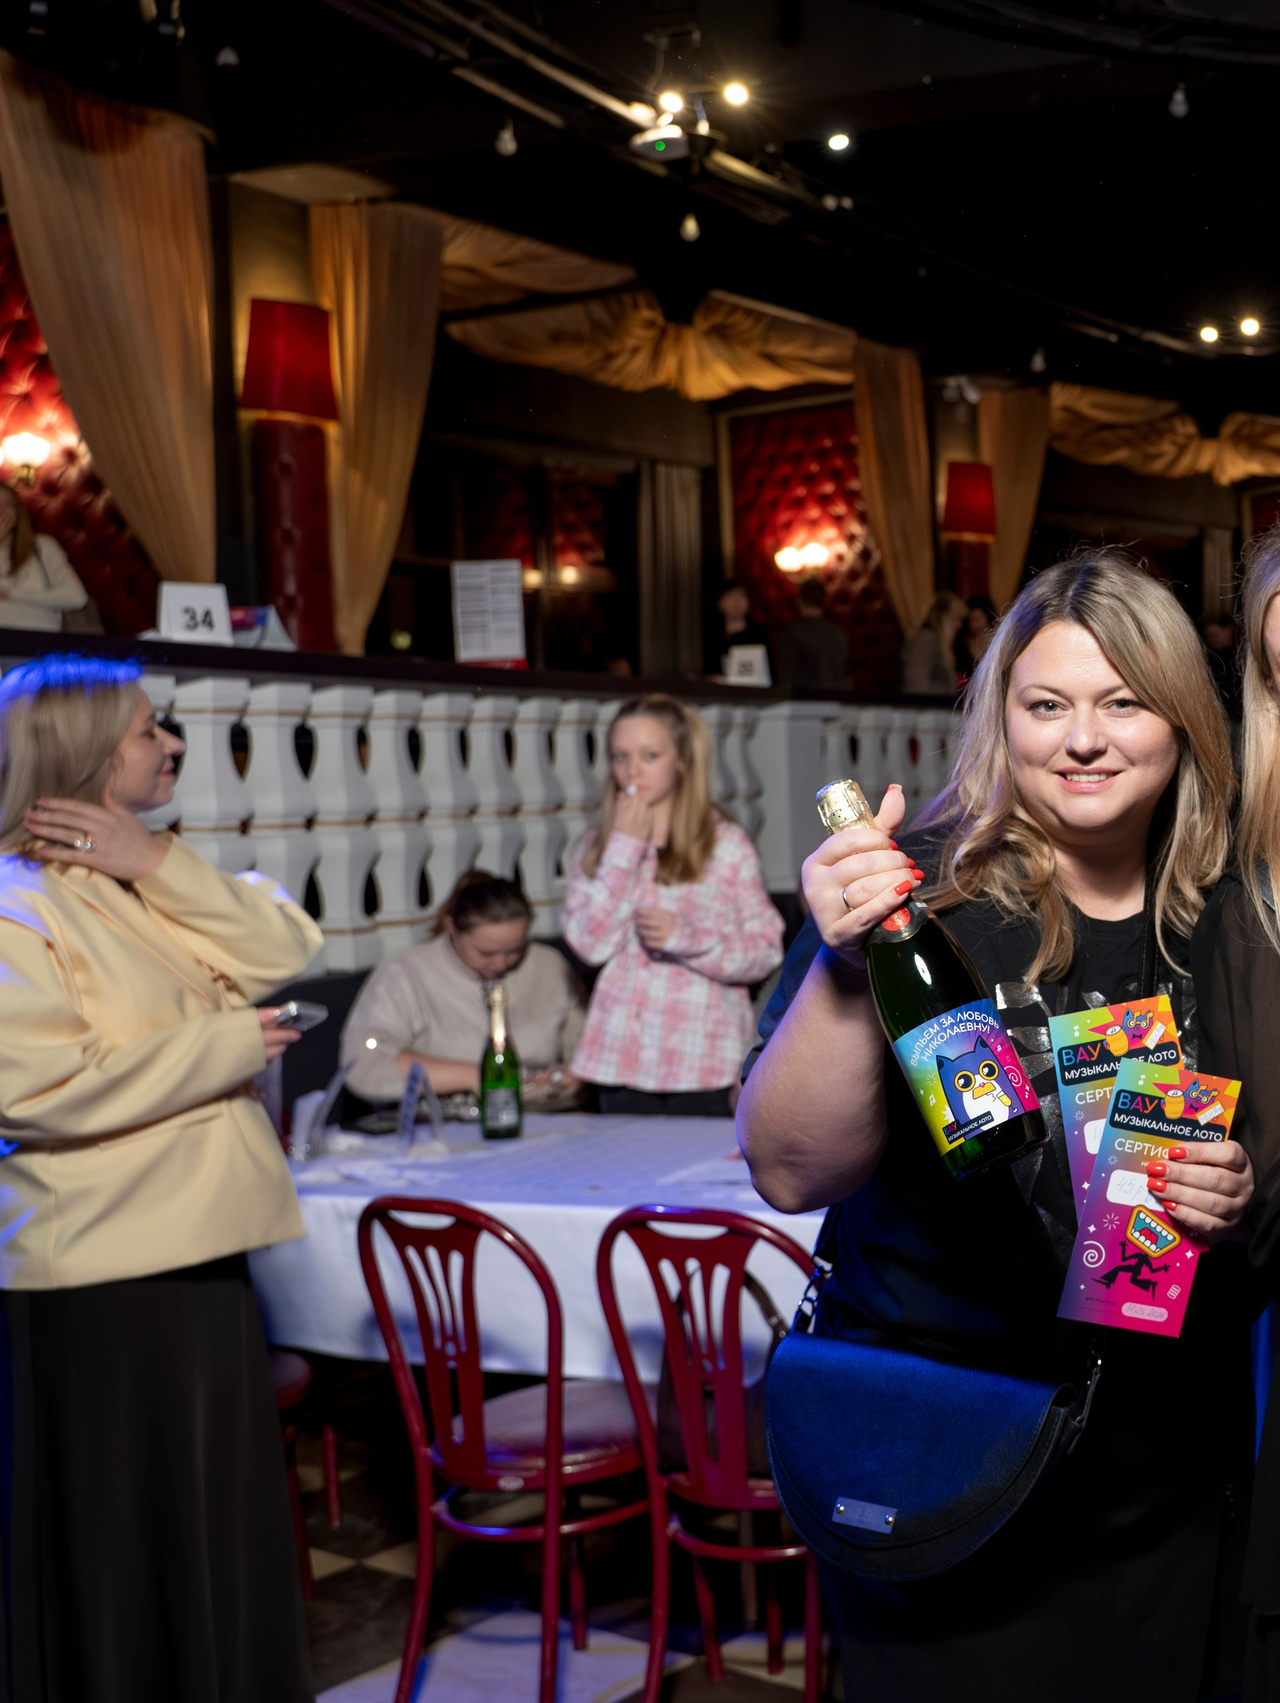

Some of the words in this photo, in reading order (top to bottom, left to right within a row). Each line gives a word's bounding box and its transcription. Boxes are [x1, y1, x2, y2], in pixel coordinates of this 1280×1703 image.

[182, 605, 215, 632] 34
[910, 1023, 940, 1067] ВЫПЬЕМ
[940, 1015, 955, 1028] ЗА
[956, 1011, 1000, 1029] ЛЮБОВЬ
[922, 1022, 990, 1061] НИКОЛАЕВНУ!
[1062, 1043, 1101, 1066] ВАУ
[1147, 1050, 1177, 1063] ЛОТО
[1075, 1086, 1115, 1105] СЕРТ
[1117, 1092, 1159, 1114] ВАУ
[1113, 1113, 1192, 1136] МУЗЫКАЛЬНОЕ
[1192, 1129, 1223, 1142] ЛОТО
